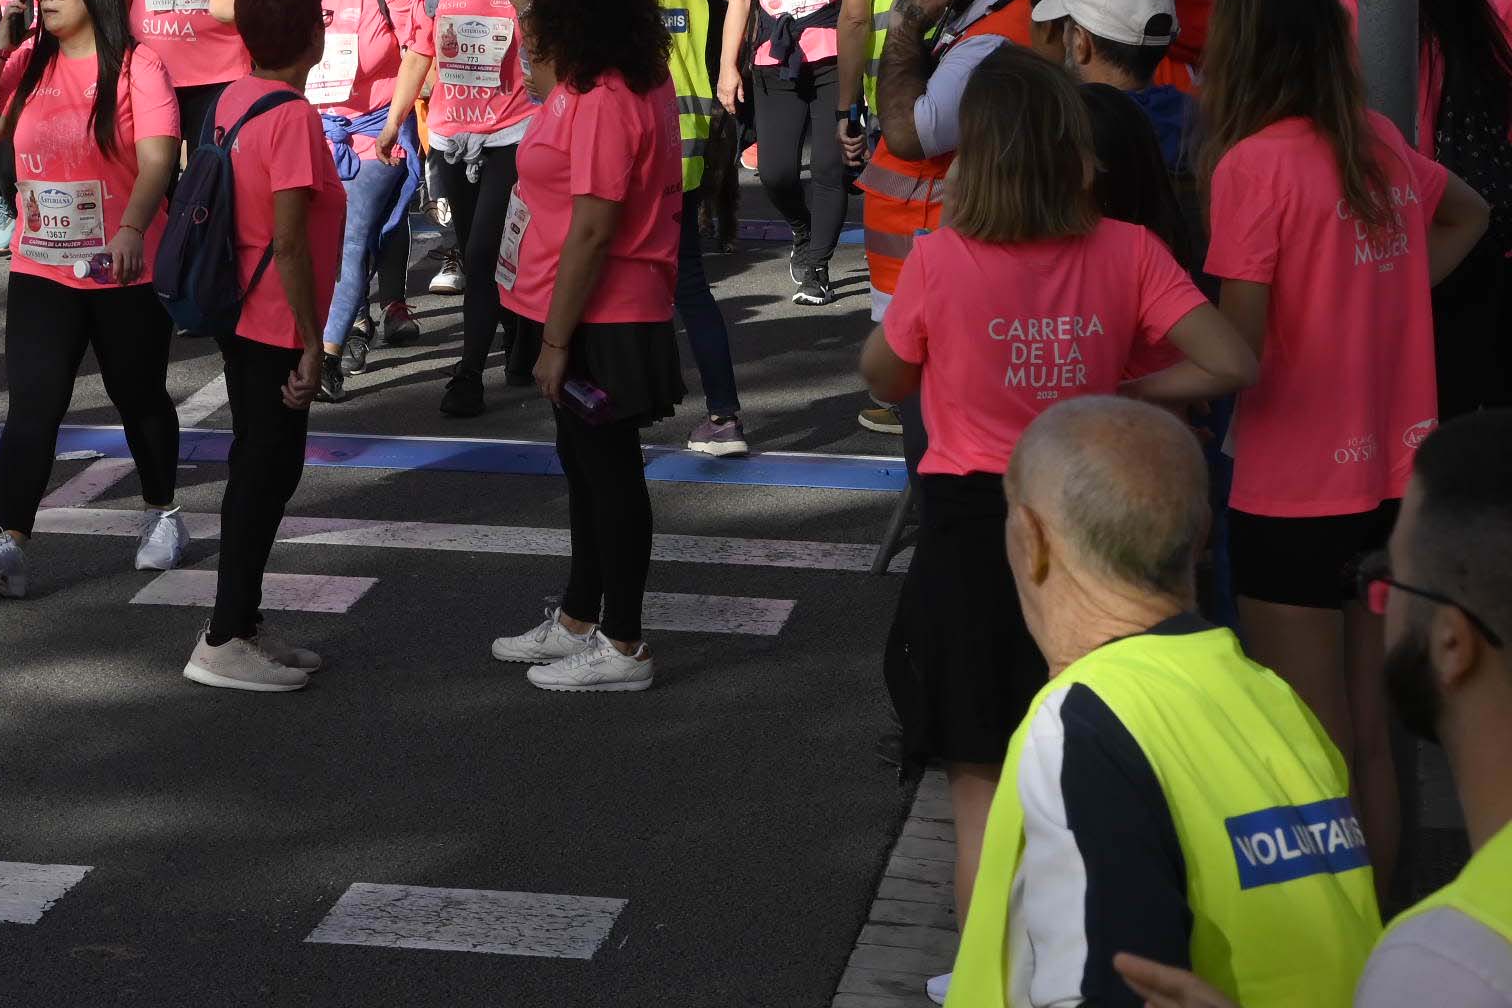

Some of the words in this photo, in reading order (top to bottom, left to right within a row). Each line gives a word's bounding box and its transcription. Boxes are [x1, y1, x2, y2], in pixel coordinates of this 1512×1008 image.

[142, 19, 195, 36] SUMA
[460, 43, 486, 53] 016
[445, 105, 497, 123] SUMA
[20, 154, 43, 174] TU
[40, 195, 72, 205] ASTURIANA
[42, 215, 71, 228] 016
[46, 230, 67, 239] 13637
[988, 313, 1105, 341] CARRERA
[1011, 342, 1044, 365] DE
[1053, 342, 1083, 365] LA
[1004, 363, 1088, 389] MUJER
[1036, 390, 1059, 400] 2023
